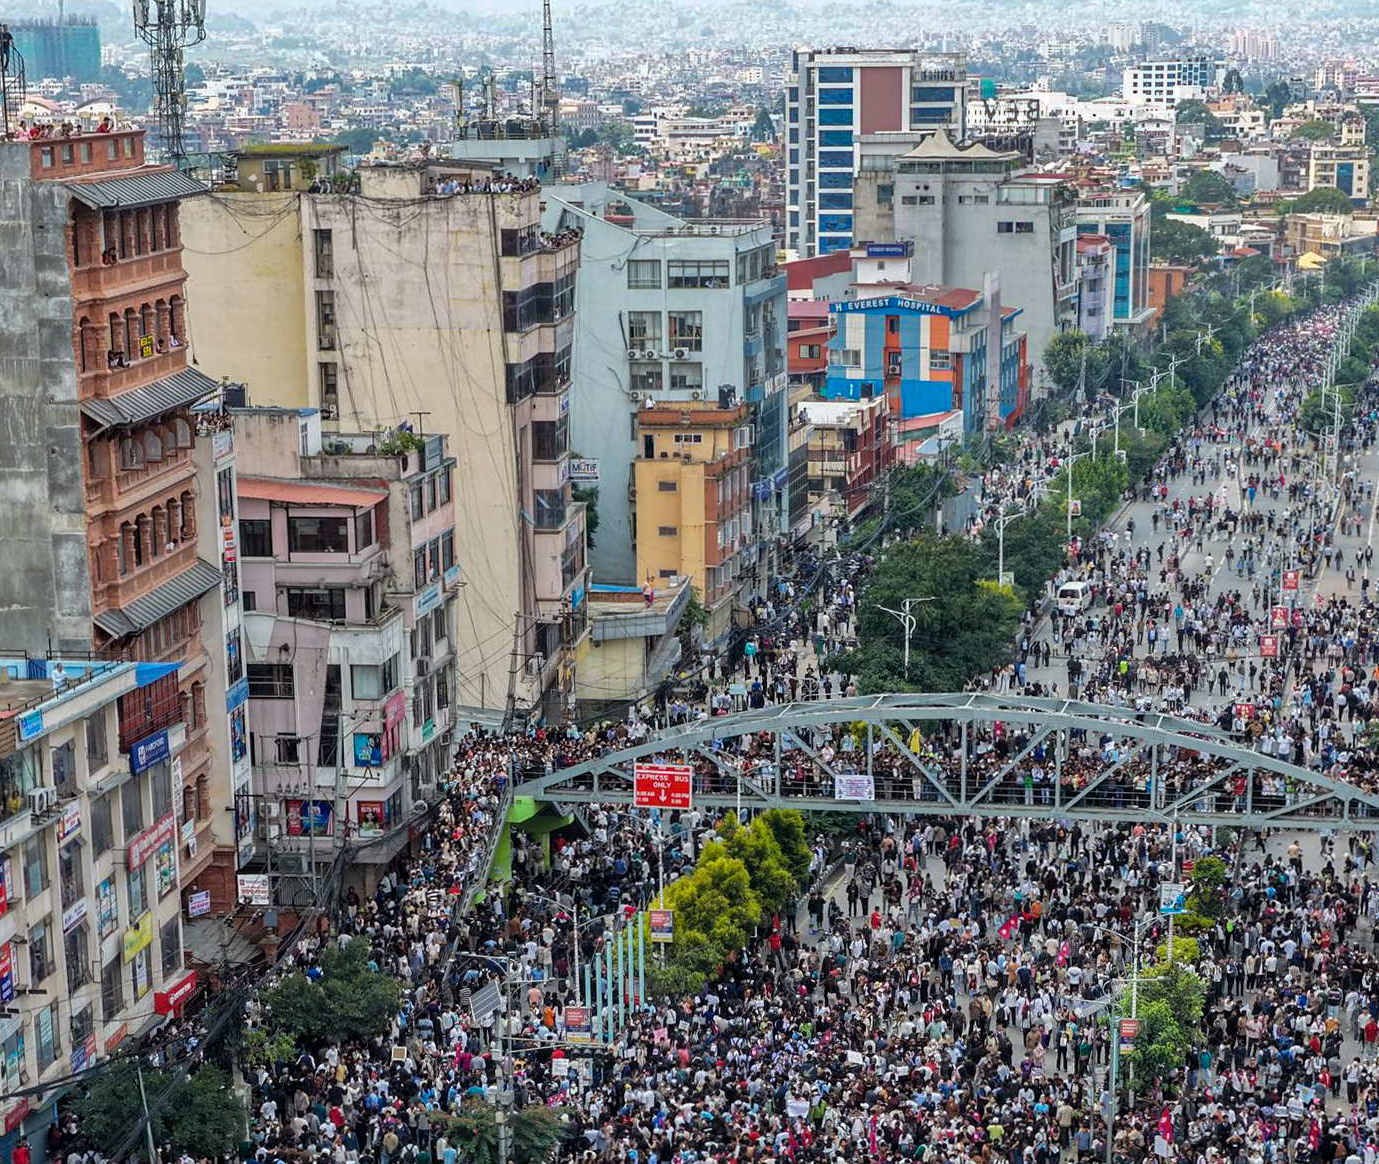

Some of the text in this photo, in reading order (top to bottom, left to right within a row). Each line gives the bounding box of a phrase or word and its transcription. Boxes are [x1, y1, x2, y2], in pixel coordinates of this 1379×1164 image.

[835, 299, 942, 314] H EVEREST HOSPITAL
[145, 737, 164, 751] HARDFORD
[674, 775, 689, 783] BUS
